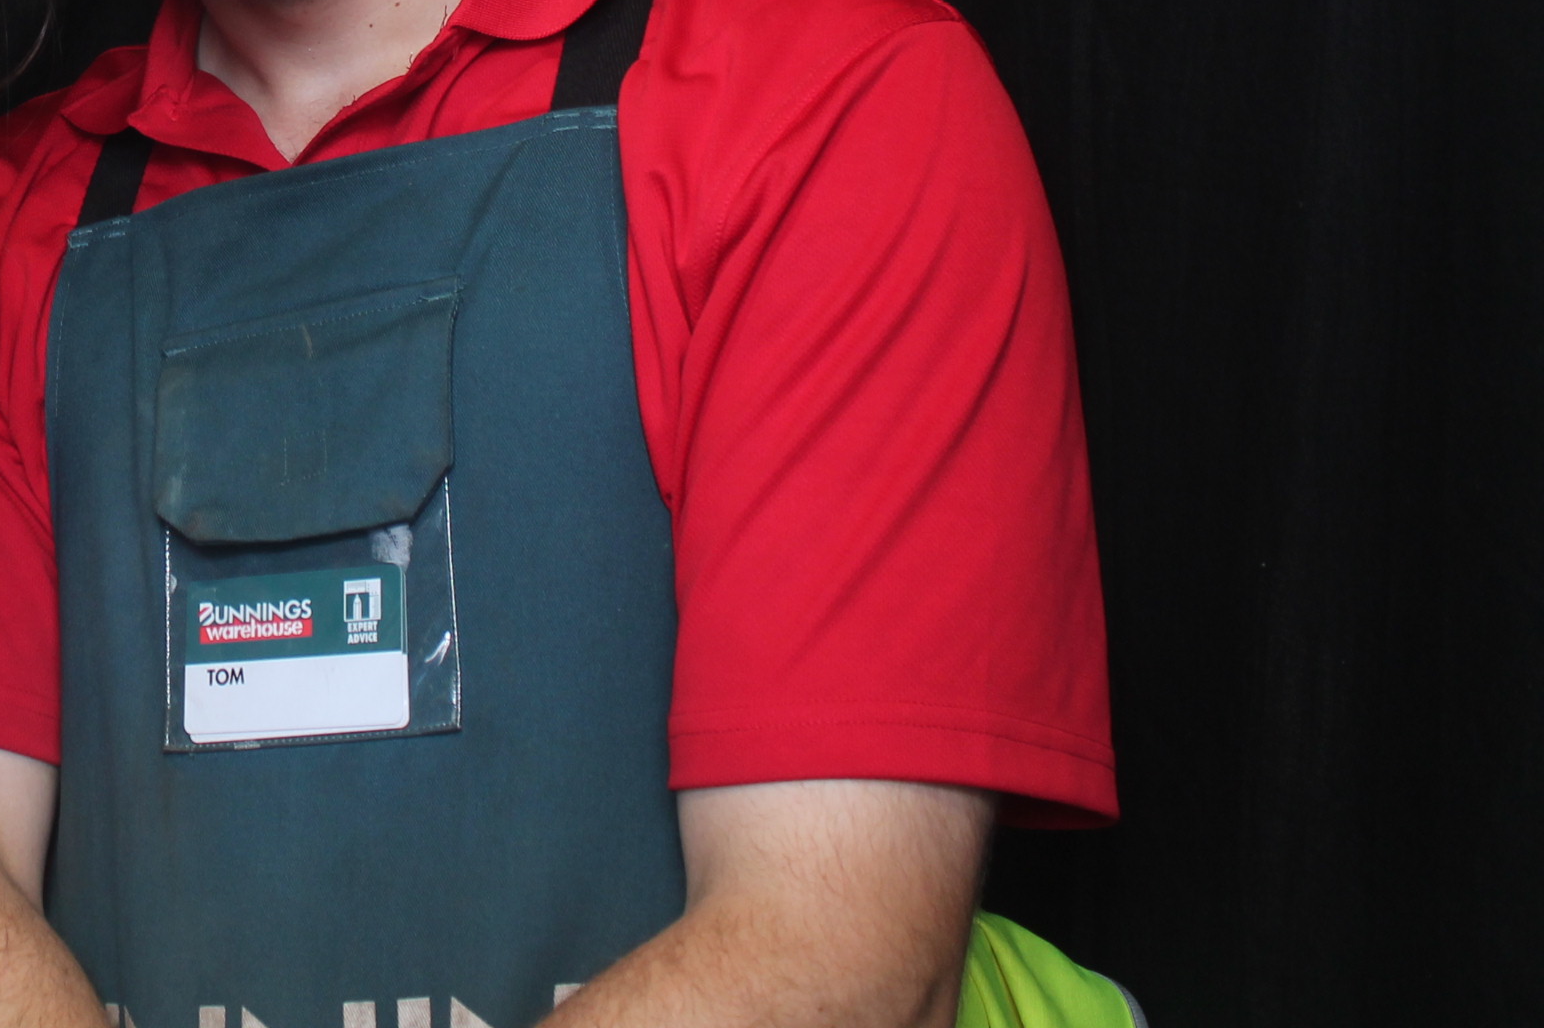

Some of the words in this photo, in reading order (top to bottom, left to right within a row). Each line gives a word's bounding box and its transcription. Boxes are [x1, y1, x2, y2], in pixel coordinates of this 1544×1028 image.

[199, 598, 312, 626] BUNNINGS
[206, 617, 304, 641] warehouse
[347, 620, 378, 633] EXPERT
[347, 632, 378, 645] ADVICE
[207, 667, 245, 686] TOM
